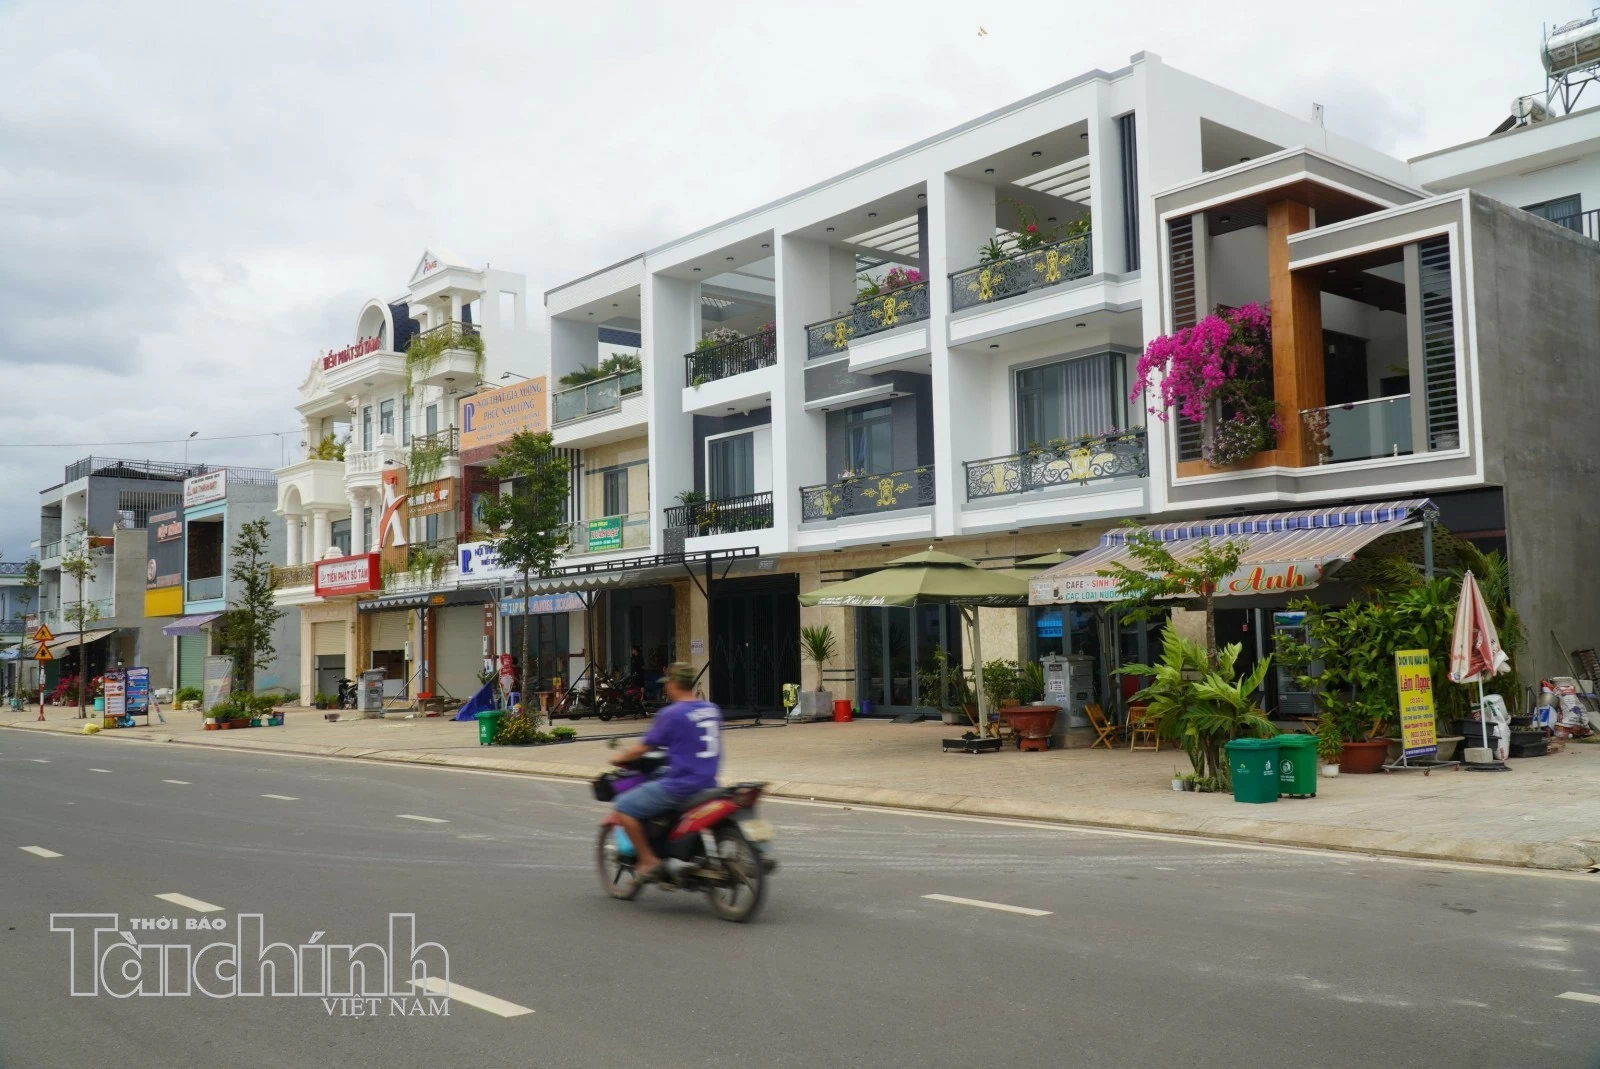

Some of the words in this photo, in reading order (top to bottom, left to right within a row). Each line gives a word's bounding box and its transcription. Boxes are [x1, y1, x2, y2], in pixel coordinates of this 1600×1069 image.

[338, 568, 350, 582] PHÁT
[351, 564, 358, 580] SỐ
[1066, 580, 1084, 589] CAFE
[1092, 578, 1109, 588] SINH
[1228, 564, 1312, 592] Anh
[695, 720, 719, 758] 3
